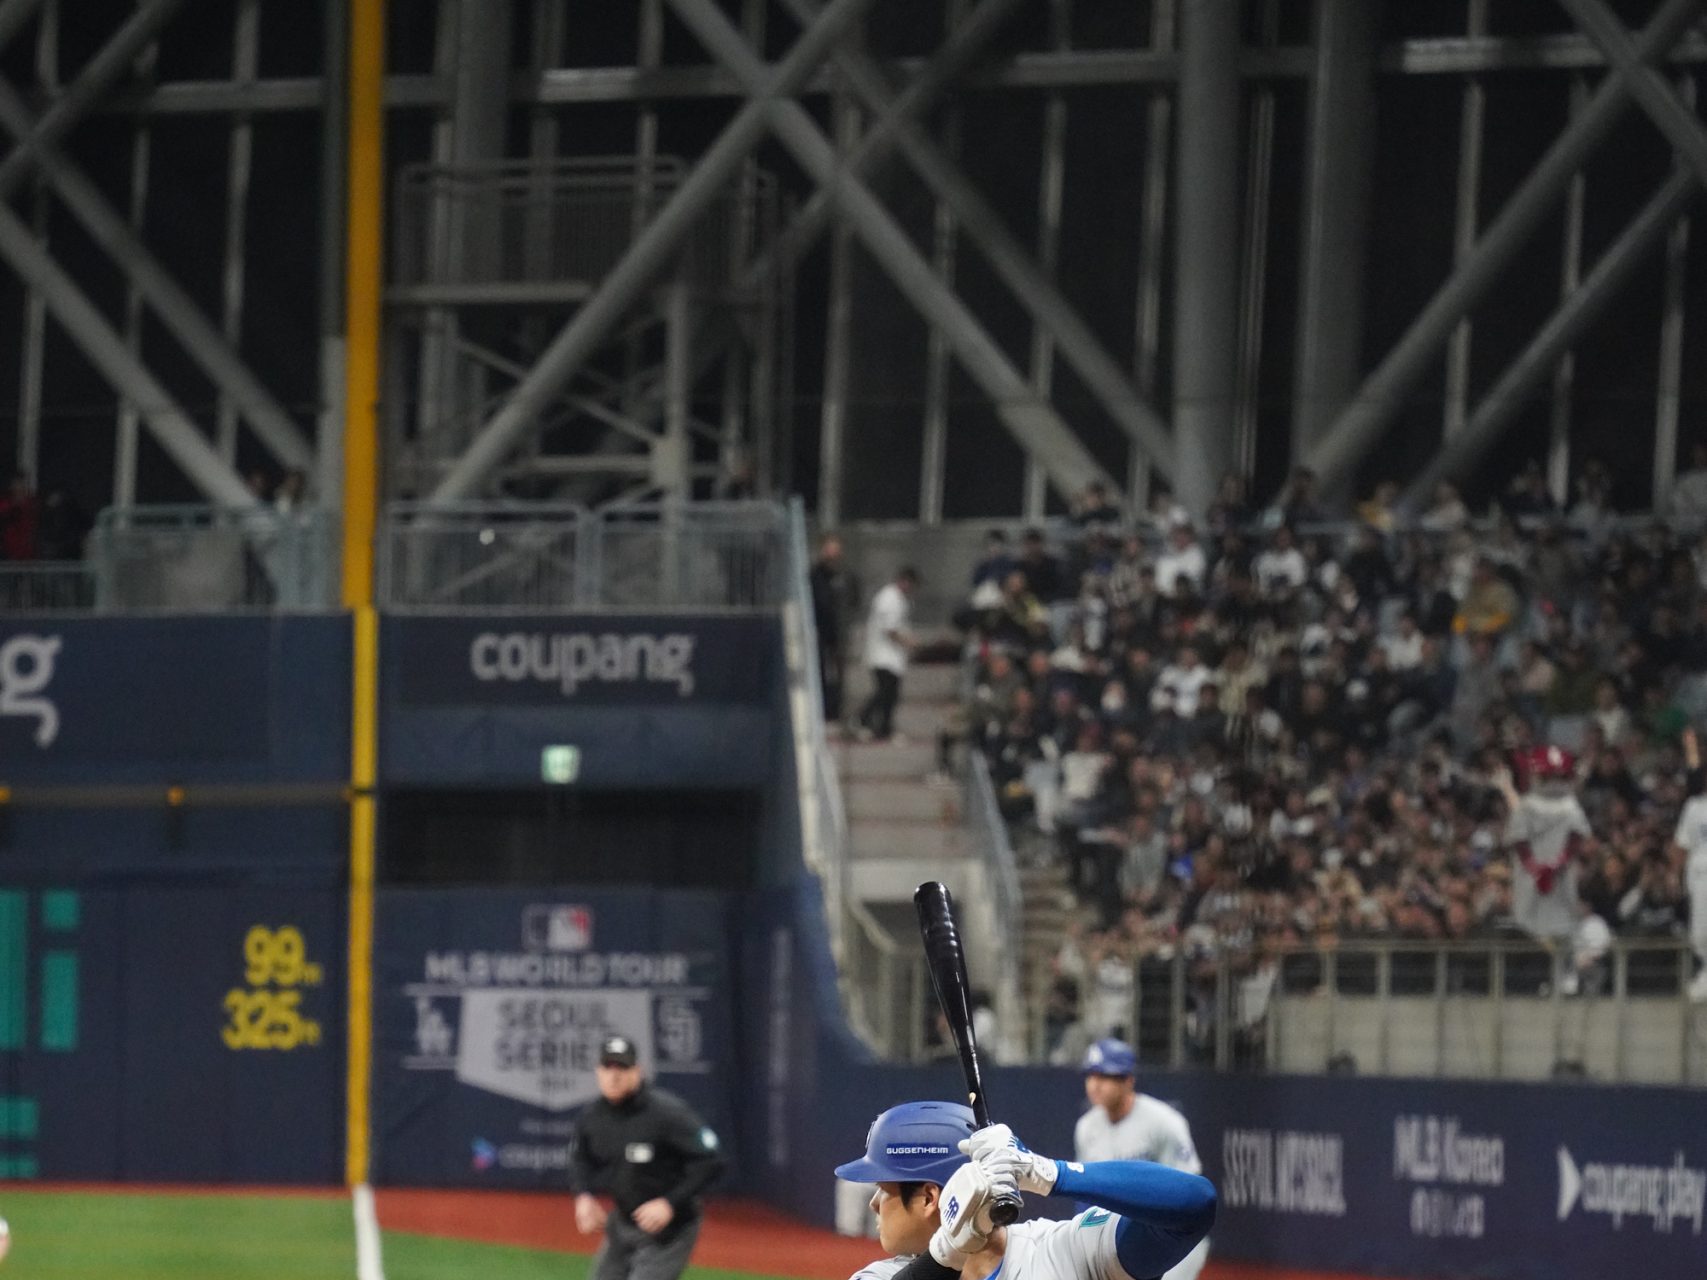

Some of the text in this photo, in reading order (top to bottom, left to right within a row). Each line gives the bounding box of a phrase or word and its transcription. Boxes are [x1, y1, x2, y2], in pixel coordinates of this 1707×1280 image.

[471, 633, 694, 696] coupang
[495, 952, 605, 983] WORLD
[608, 952, 688, 983] TOUR
[497, 1000, 607, 1028] SEOUL
[496, 1040, 600, 1071] SERIE
[886, 1146, 949, 1155] GUGGENHEIM
